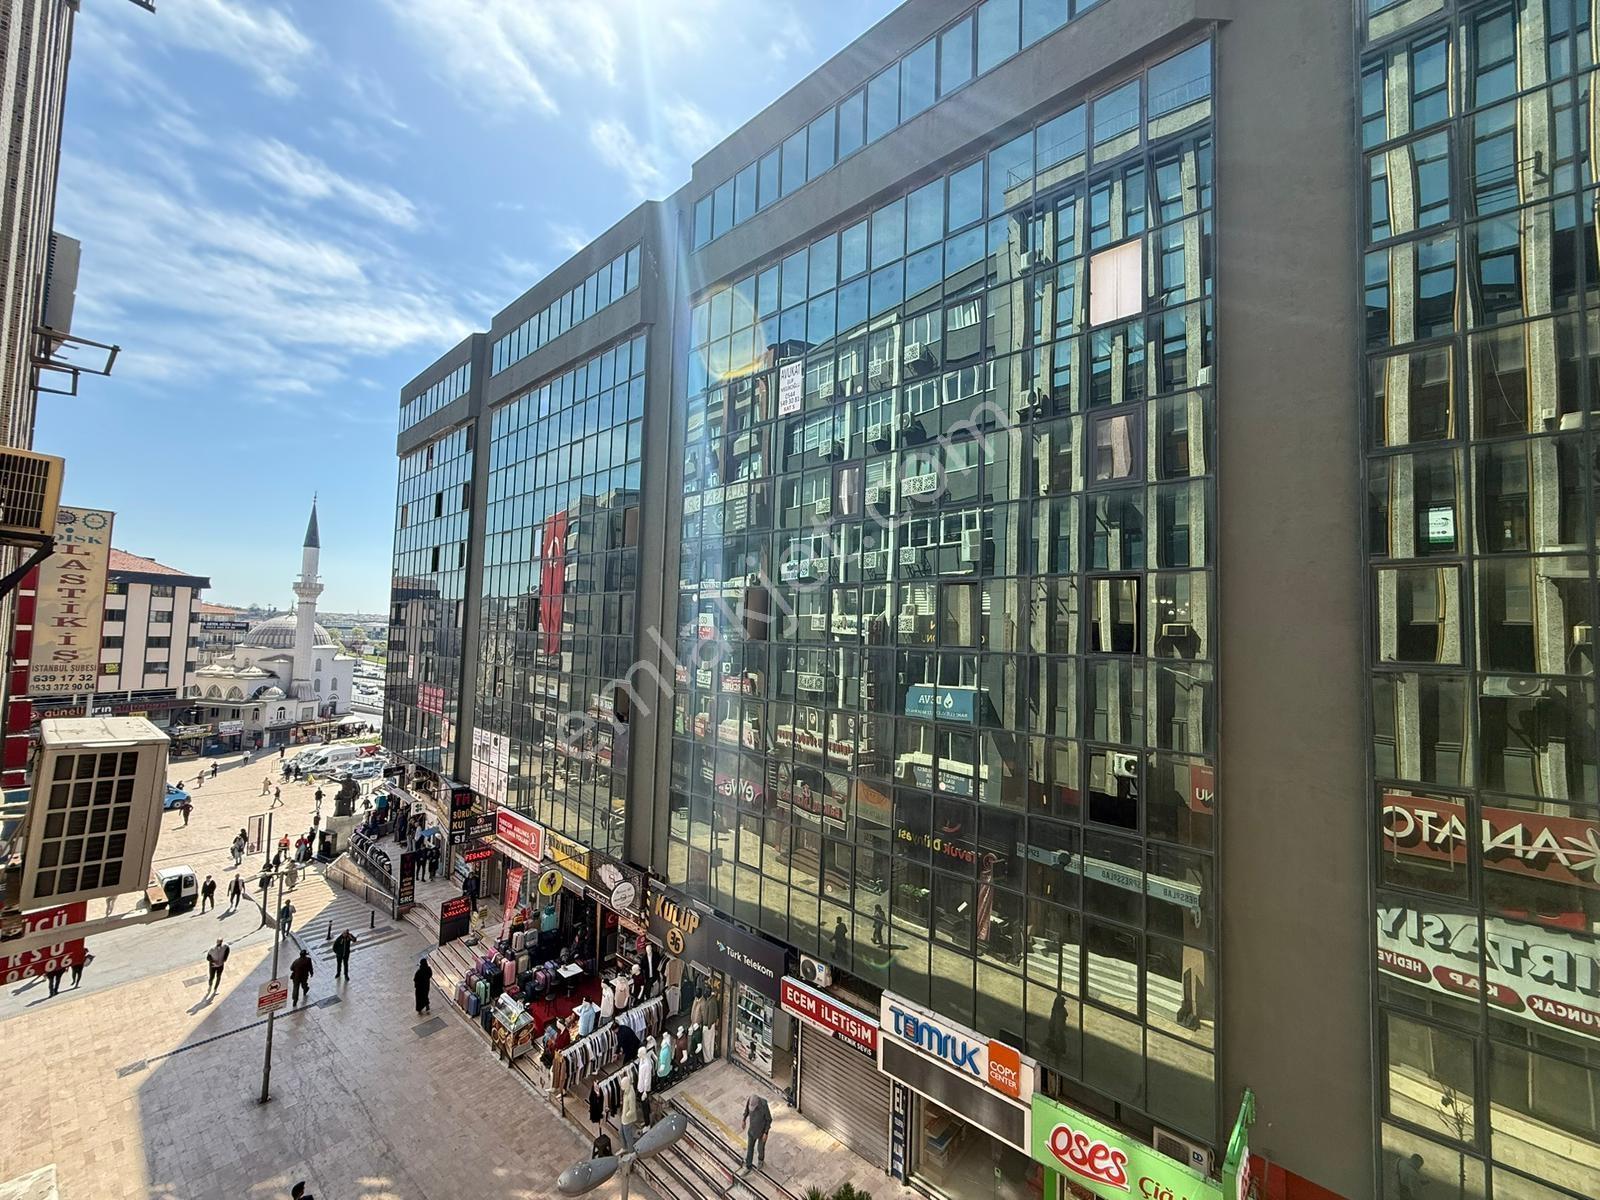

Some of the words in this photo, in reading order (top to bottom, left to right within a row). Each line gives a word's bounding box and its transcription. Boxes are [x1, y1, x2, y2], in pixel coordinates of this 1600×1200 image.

[33, 674, 56, 682] 639
[61, 674, 75, 682] 17
[79, 674, 93, 682] 32
[72, 683, 83, 691] 90
[654, 893, 701, 935] KULÜP
[669, 931, 682, 952] 36
[726, 945, 742, 961] Türk
[742, 953, 775, 979] Telekom
[786, 986, 817, 1014] ECEM
[821, 1004, 872, 1045] İLETİŞİM
[989, 1060, 1018, 1082] COPY
[989, 1070, 1018, 1091] CENTER
